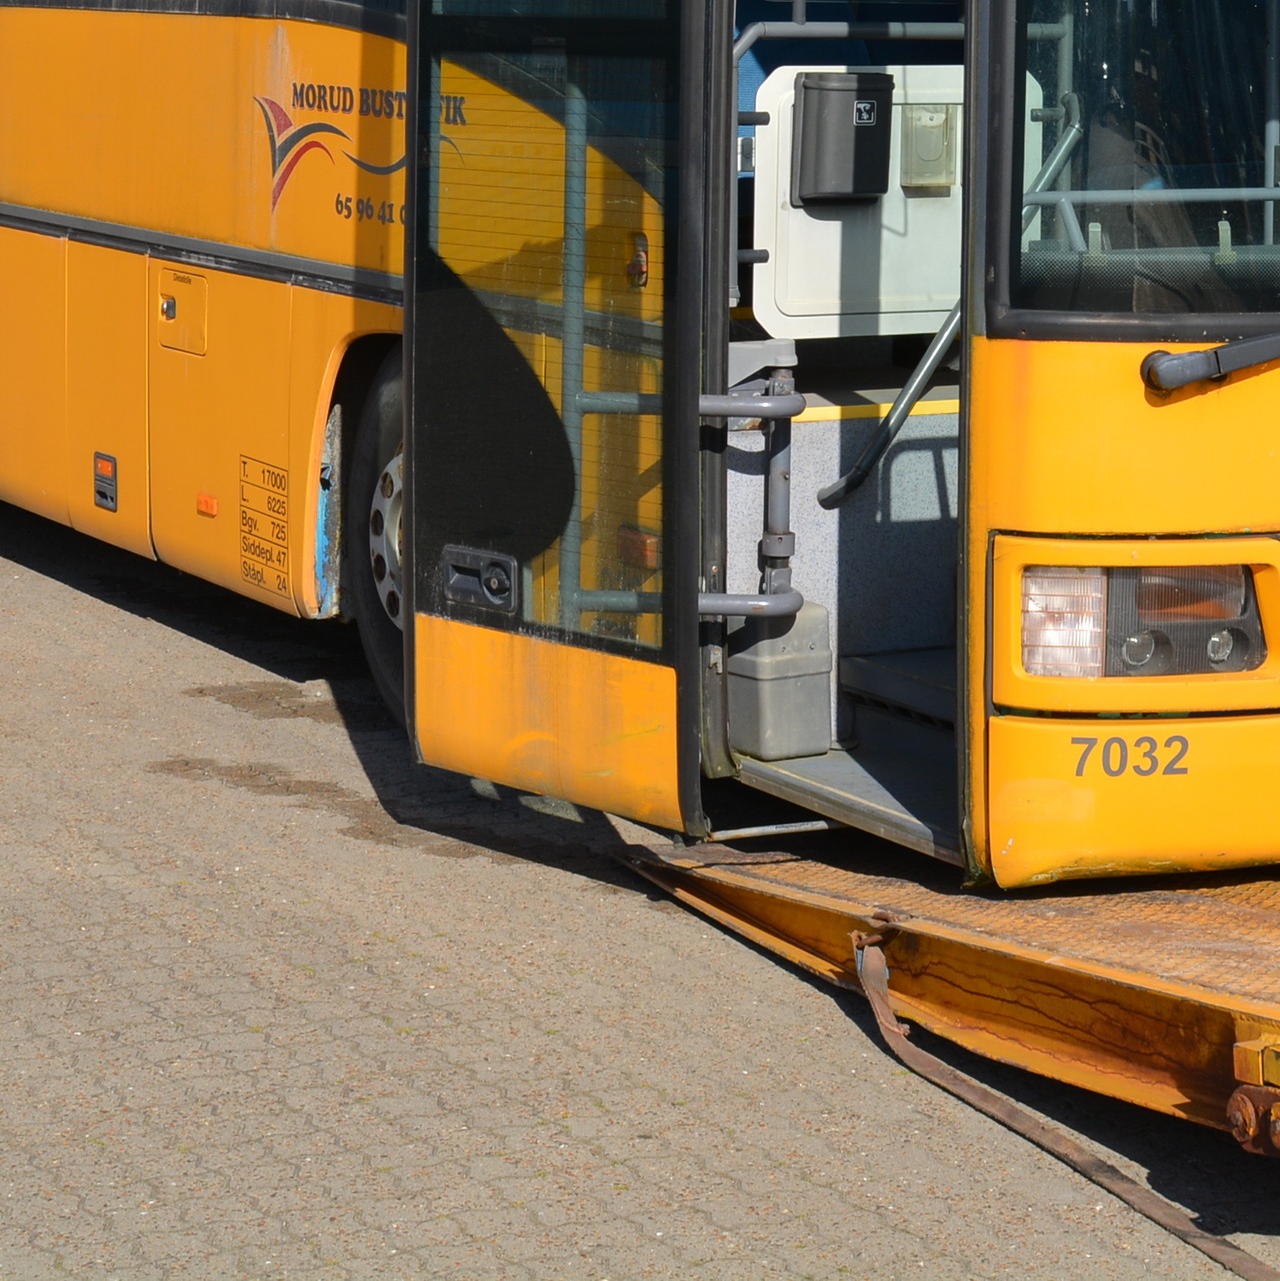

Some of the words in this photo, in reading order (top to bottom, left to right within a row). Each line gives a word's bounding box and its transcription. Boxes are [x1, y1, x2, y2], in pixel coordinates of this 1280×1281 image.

[292, 82, 354, 113] MORUD
[335, 193, 352, 219] 65
[356, 197, 374, 222] 96
[377, 201, 395, 225] 41
[241, 461, 249, 478] T.
[261, 468, 286, 491] 17000
[241, 485, 249, 503] L.
[267, 495, 286, 517] 6225
[241, 510, 259, 533] Bgv.
[271, 521, 286, 542] 725
[241, 535, 275, 564] Siddepl.
[276, 550, 286, 568] 47
[242, 561, 266, 585] Ståpl.
[276, 574, 287, 593] 24
[1071, 735, 1189, 777] 7032
